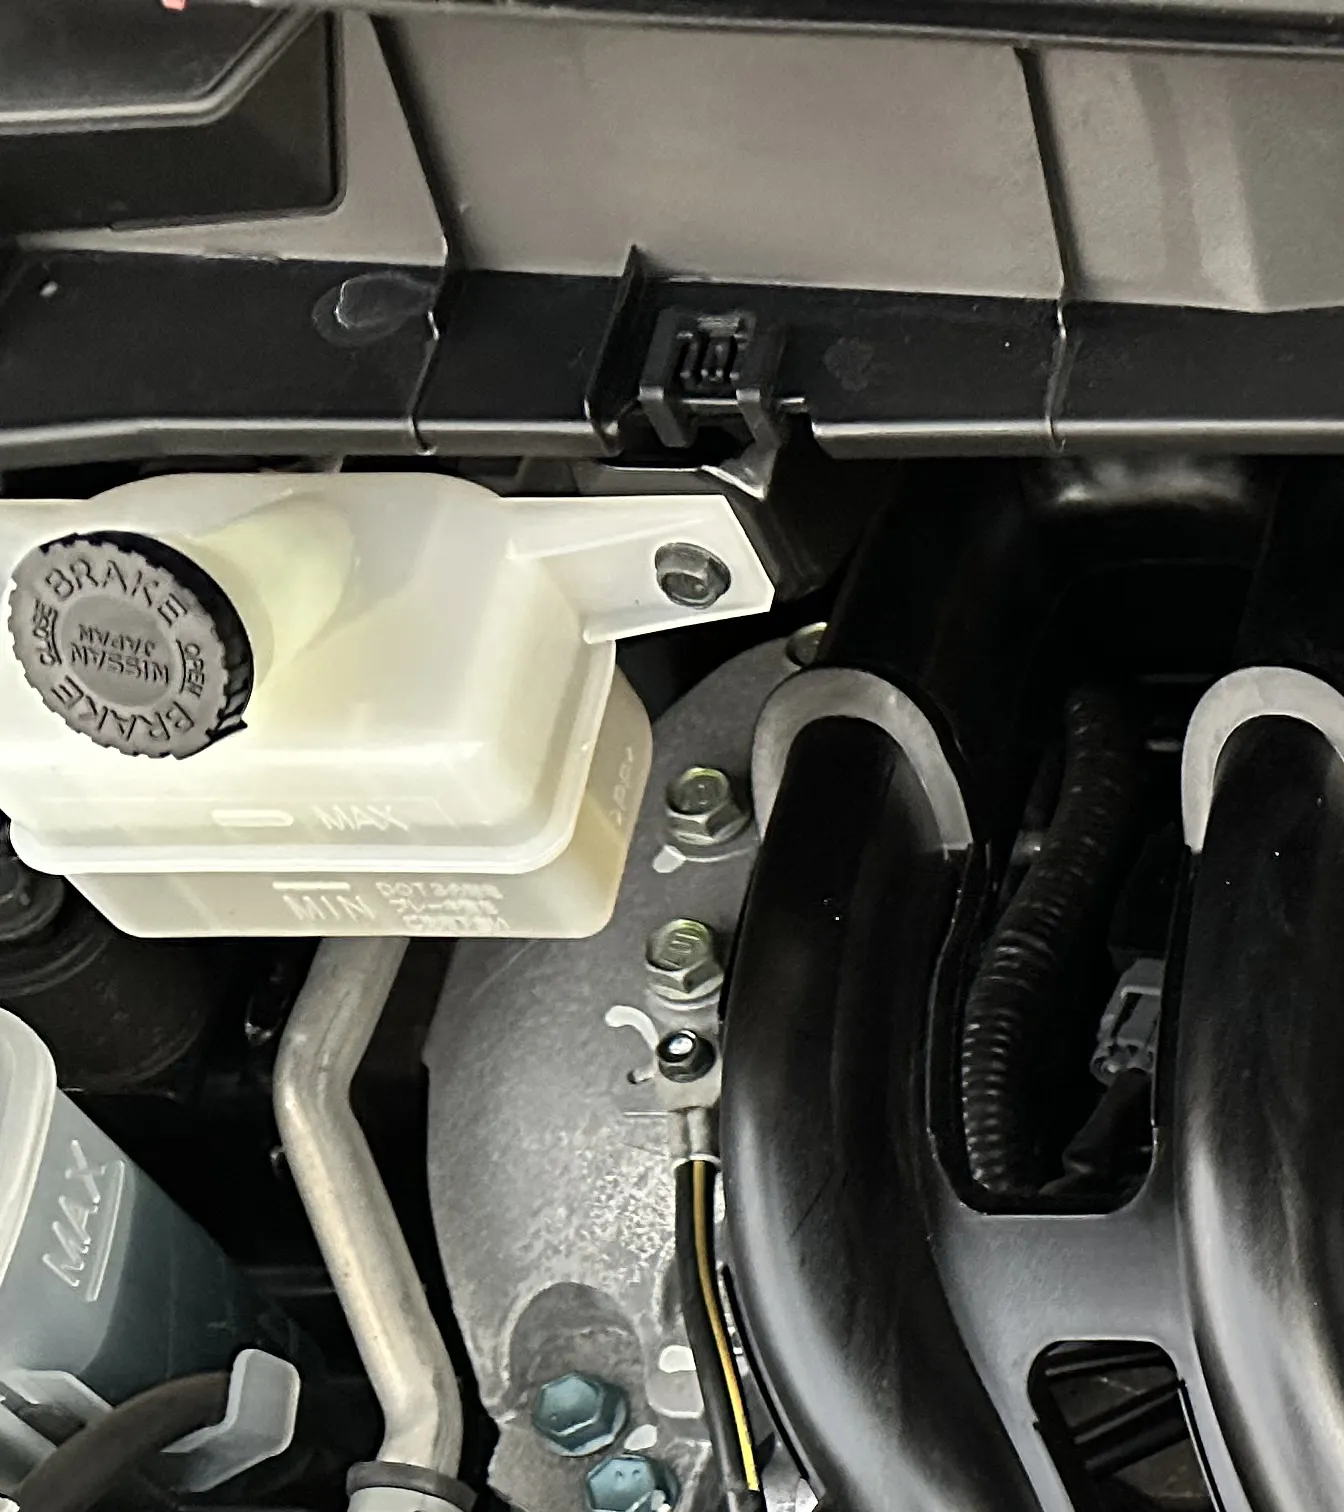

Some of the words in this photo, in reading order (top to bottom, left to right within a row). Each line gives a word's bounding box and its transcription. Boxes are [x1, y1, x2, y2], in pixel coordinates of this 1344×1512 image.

[45, 558, 189, 627] BRAKE
[78, 623, 156, 658] JAPAN
[70, 642, 169, 685] NISSAN
[51, 675, 195, 742] BRAKE
[311, 804, 409, 832] MAX
[283, 895, 377, 921] MIN
[42, 1140, 107, 1287] MAX
